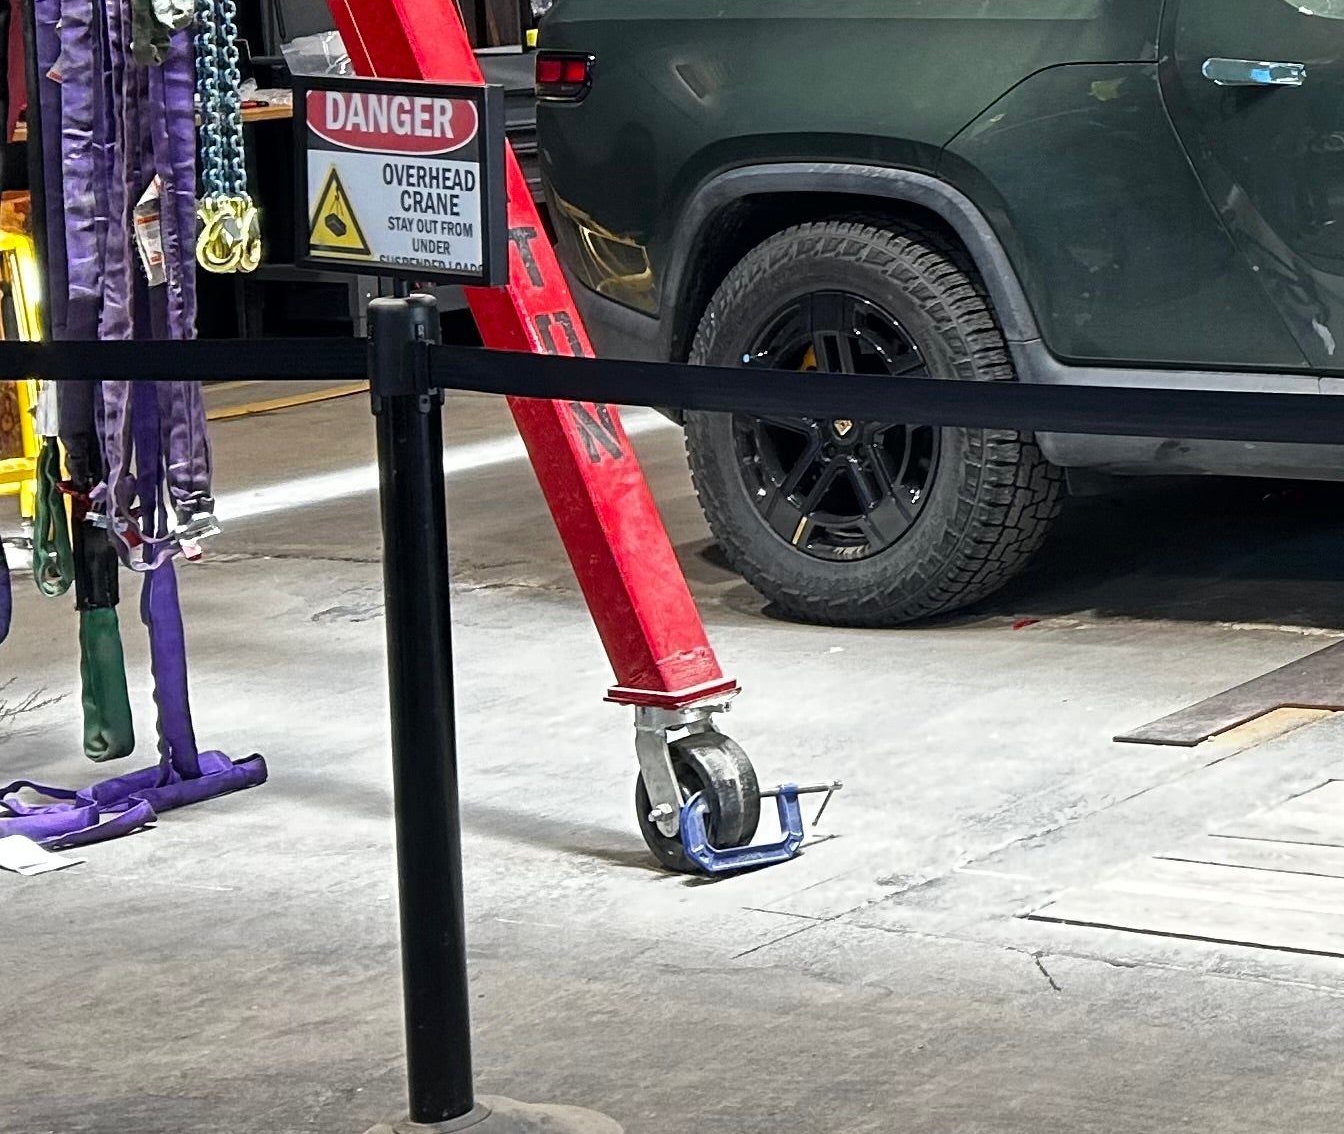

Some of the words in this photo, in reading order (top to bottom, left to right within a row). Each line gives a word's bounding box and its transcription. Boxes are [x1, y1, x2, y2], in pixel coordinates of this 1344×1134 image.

[325, 91, 455, 139] DANGER
[382, 162, 476, 192] OVERHEAD
[400, 190, 461, 217] CRANE
[387, 216, 414, 233] STAY
[416, 218, 438, 235] OUT
[441, 220, 473, 238] FROM
[412, 237, 451, 256] UNDER
